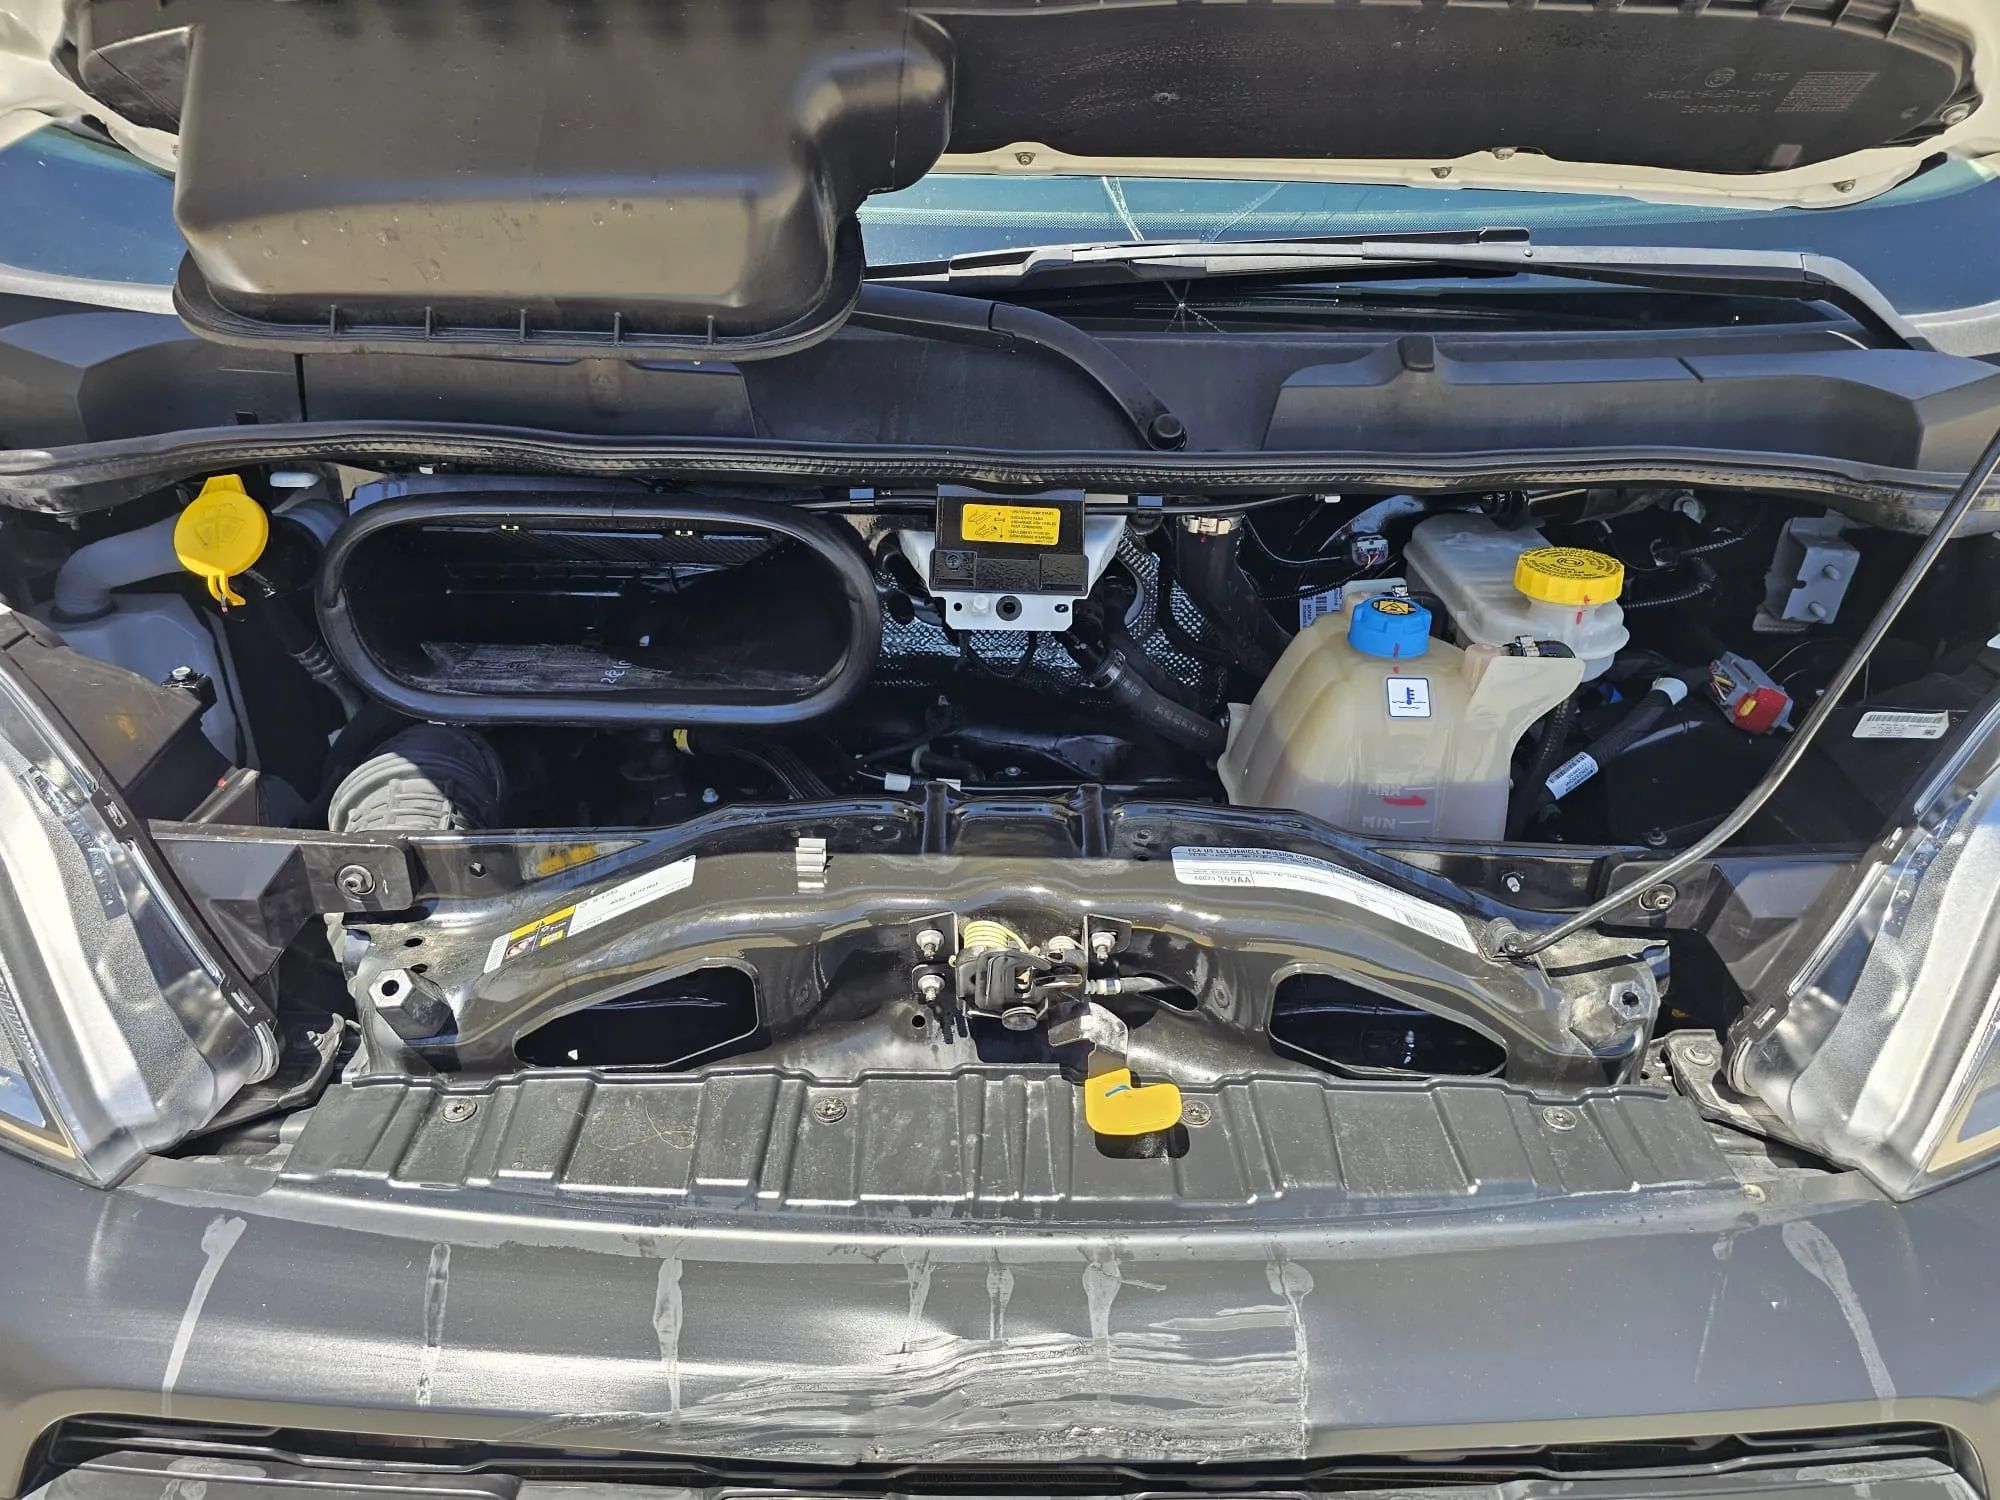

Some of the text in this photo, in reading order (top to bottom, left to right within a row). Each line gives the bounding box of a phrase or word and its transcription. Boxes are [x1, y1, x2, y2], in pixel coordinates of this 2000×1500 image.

[1362, 815, 1396, 830] MIN
[1262, 850, 1294, 858] EMISSION
[1295, 854, 1323, 865] CONTROL
